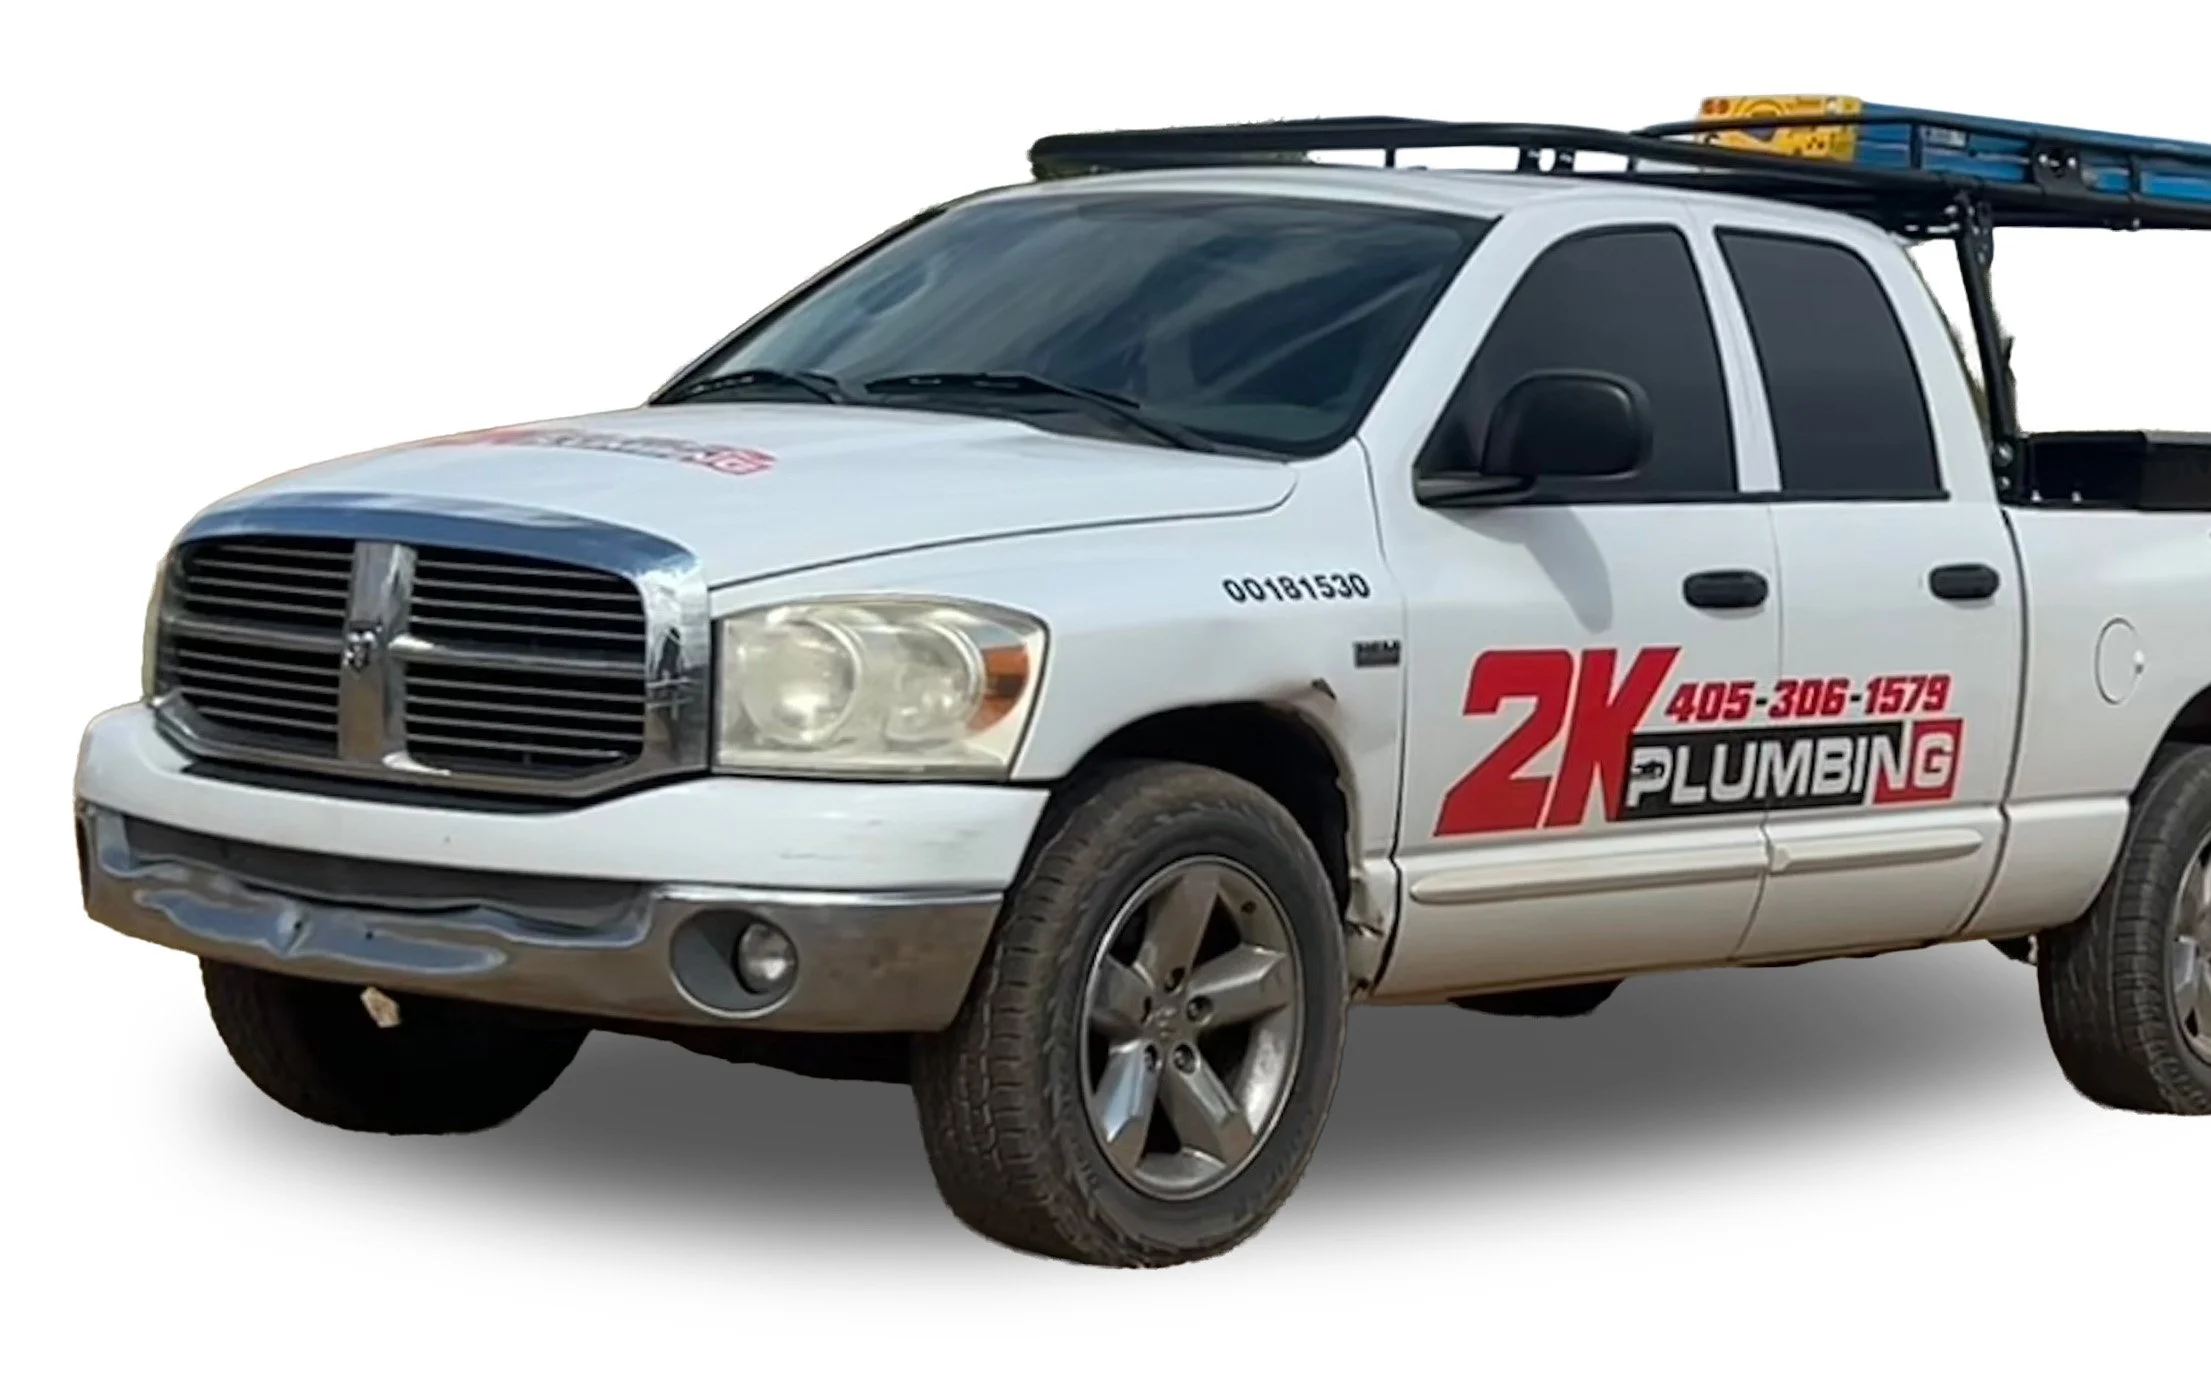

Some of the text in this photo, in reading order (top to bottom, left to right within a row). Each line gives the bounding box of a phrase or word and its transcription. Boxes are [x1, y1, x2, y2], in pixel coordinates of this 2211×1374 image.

[1222, 573, 1371, 602] 00181530
[1665, 674, 1951, 723] 405-306-1579
[1434, 646, 1681, 837] 2K
[1627, 730, 1954, 808] PLUMBING
